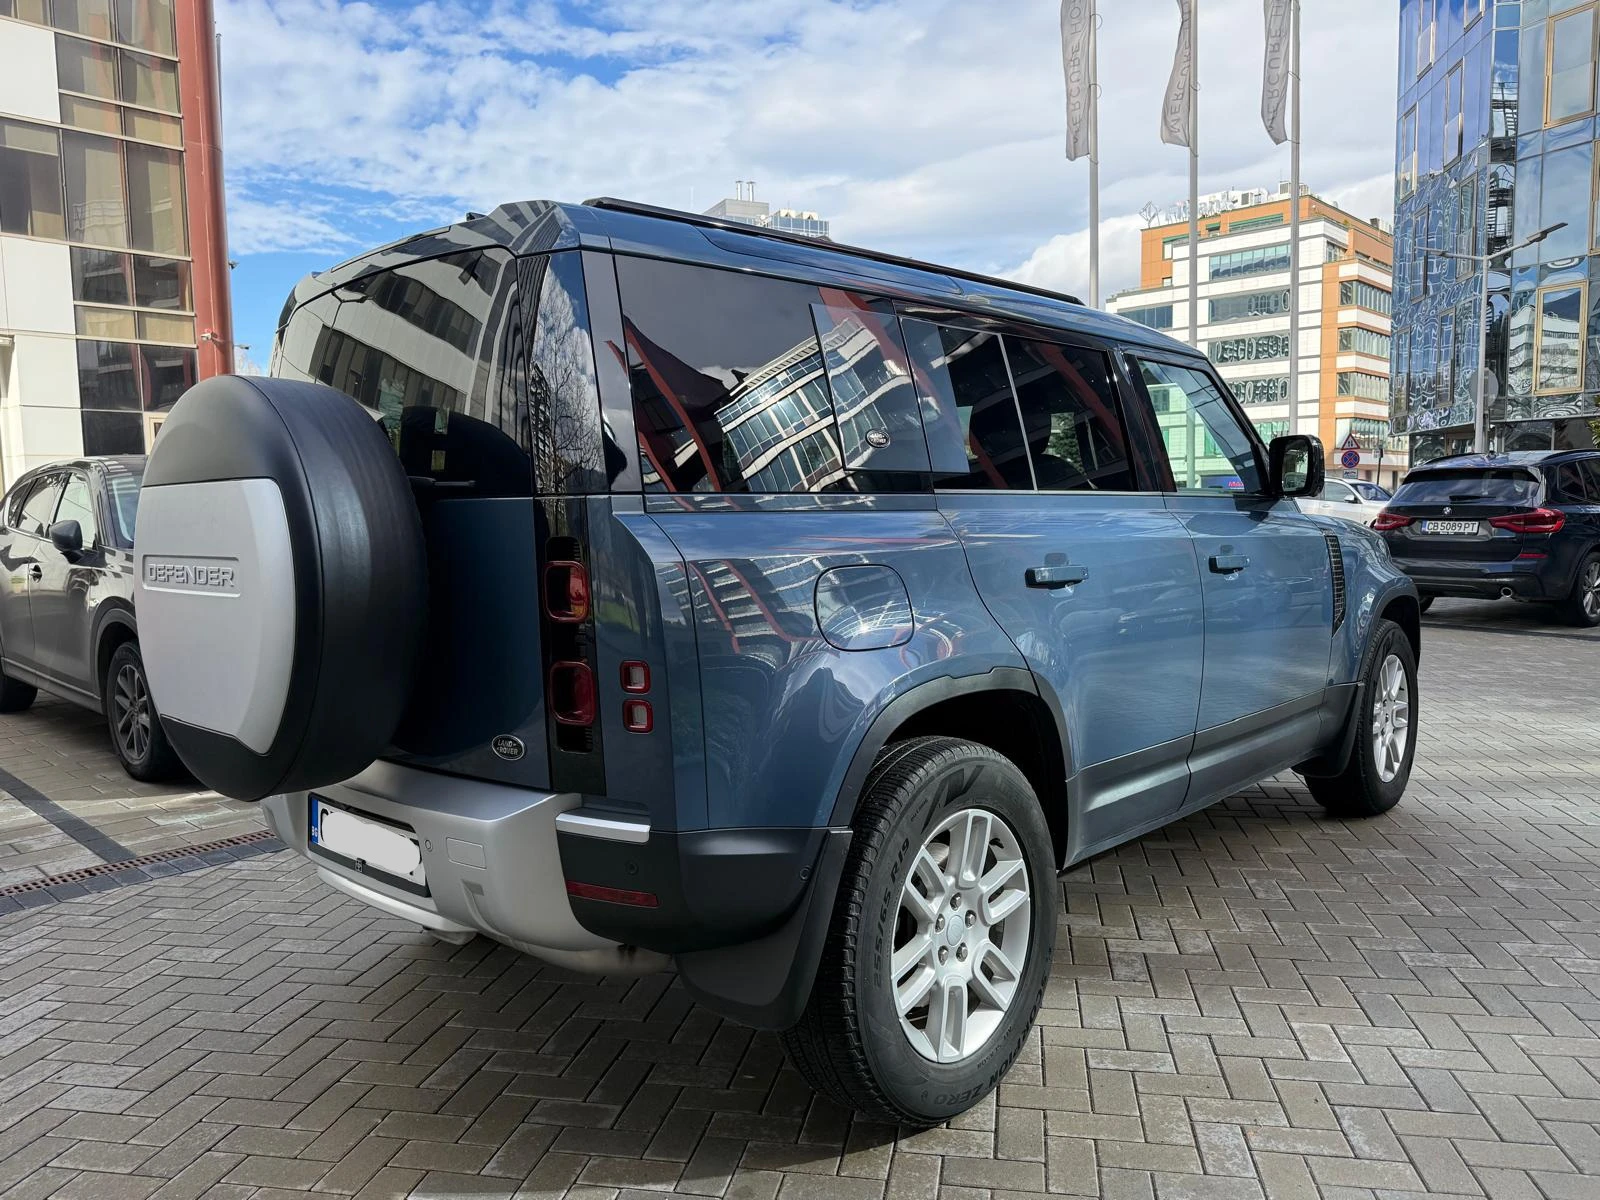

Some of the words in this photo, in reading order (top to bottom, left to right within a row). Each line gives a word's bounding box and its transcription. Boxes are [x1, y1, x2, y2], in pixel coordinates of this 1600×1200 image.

[1440, 522, 1463, 531] 5089
[147, 563, 234, 587] DEFENDER
[934, 1082, 984, 1107] ZERO
